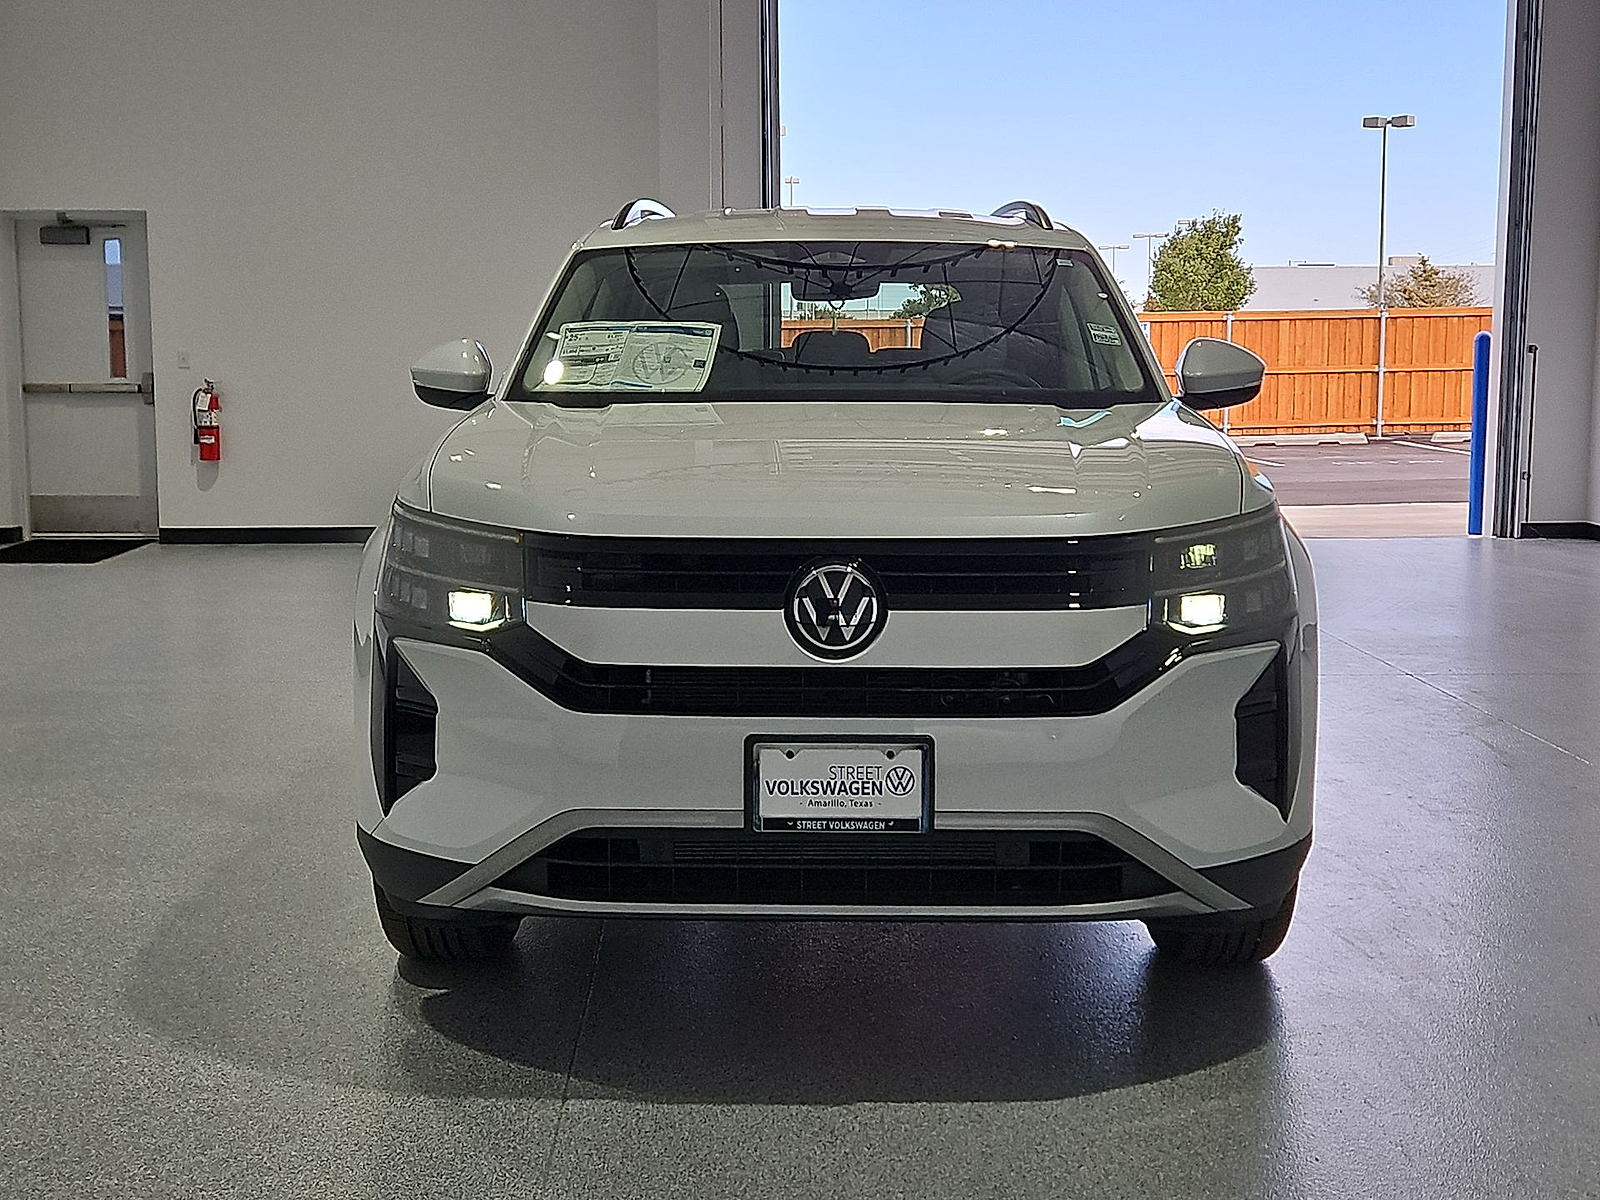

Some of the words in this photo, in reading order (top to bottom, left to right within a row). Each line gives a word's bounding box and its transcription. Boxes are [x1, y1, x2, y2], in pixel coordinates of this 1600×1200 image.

[829, 766, 883, 780] STREET
[765, 780, 883, 796] VOLKSWAGEN
[807, 799, 847, 808] Amarillo,
[849, 799, 873, 808] Texas
[796, 820, 829, 830] STREET
[829, 820, 886, 830] VOLKSWAGEN
